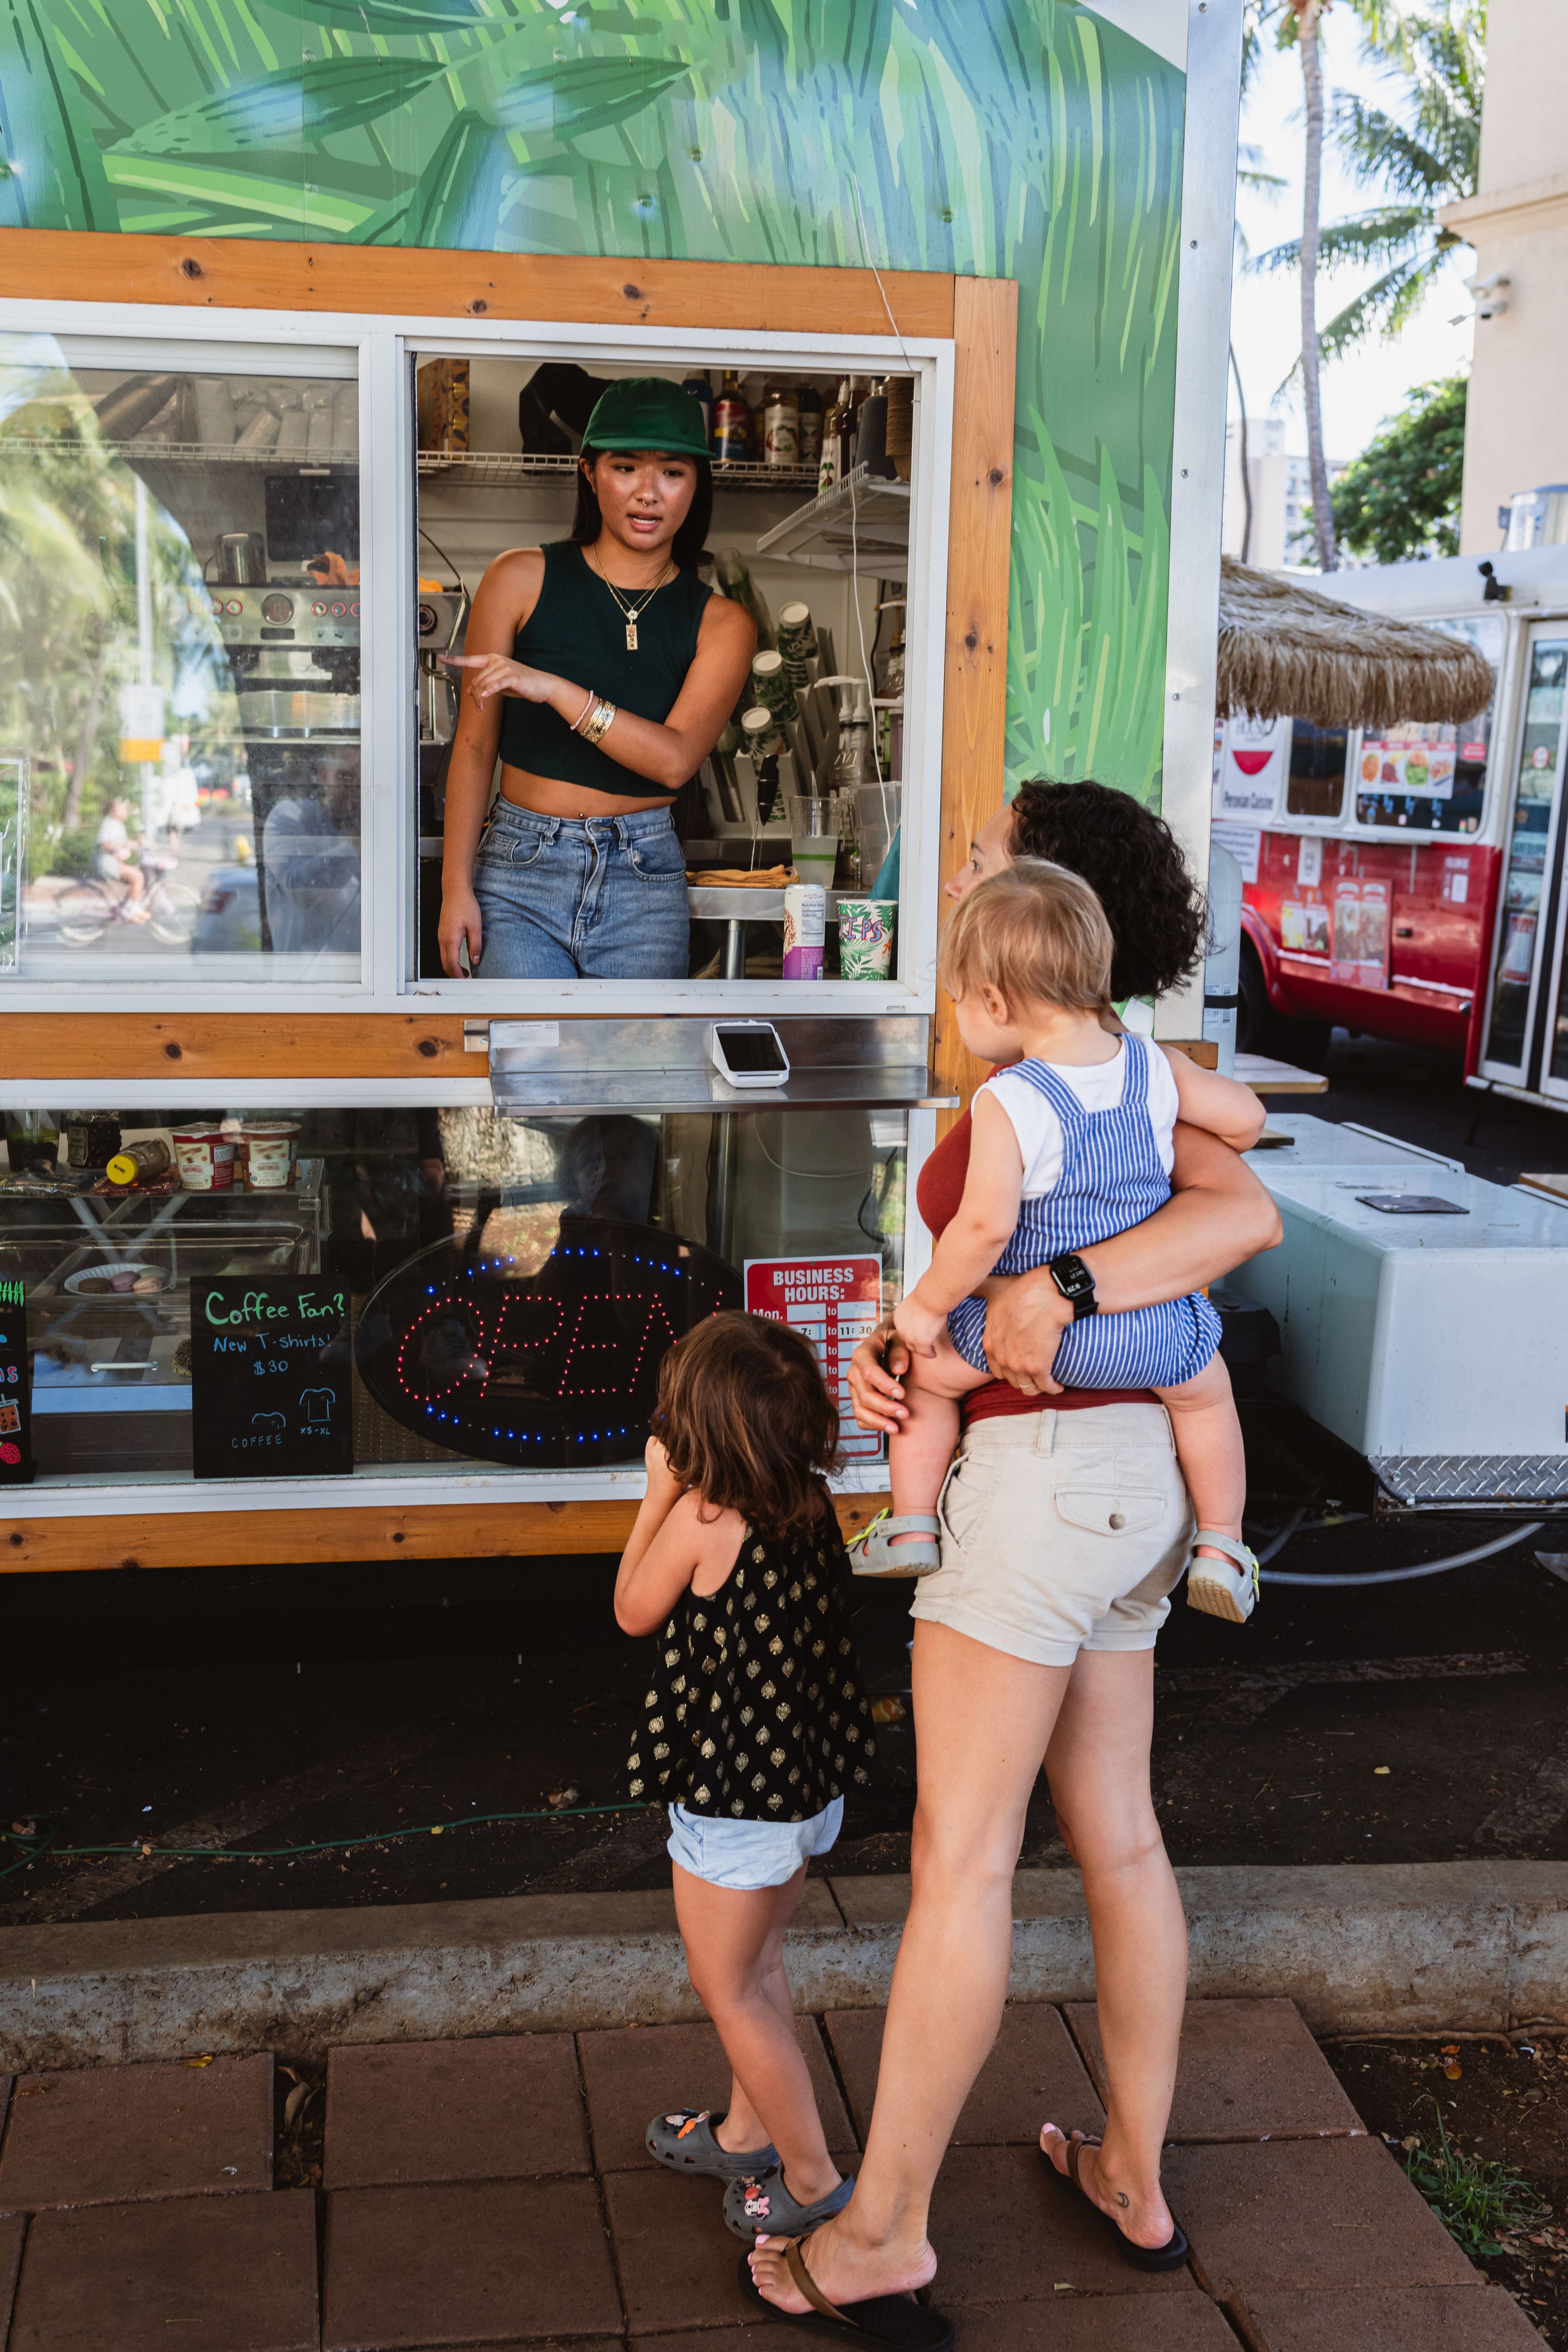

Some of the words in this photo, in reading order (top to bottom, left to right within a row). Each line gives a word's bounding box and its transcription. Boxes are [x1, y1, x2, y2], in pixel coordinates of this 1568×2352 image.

[838, 914, 883, 943] TIPS
[773, 1267, 854, 1286] BUSINESS
[785, 1285, 845, 1302] HOURS:
[205, 1291, 290, 1325] Coffee
[298, 1293, 345, 1319] Fan?
[827, 1307, 836, 1316] to
[828, 1327, 837, 1336] to
[213, 1336, 247, 1352] New
[255, 1333, 331, 1349] T-shirts!
[828, 1345, 837, 1355] to
[828, 1365, 837, 1375] to
[829, 1386, 838, 1394] to
[231, 1434, 283, 1449] COFFEE
